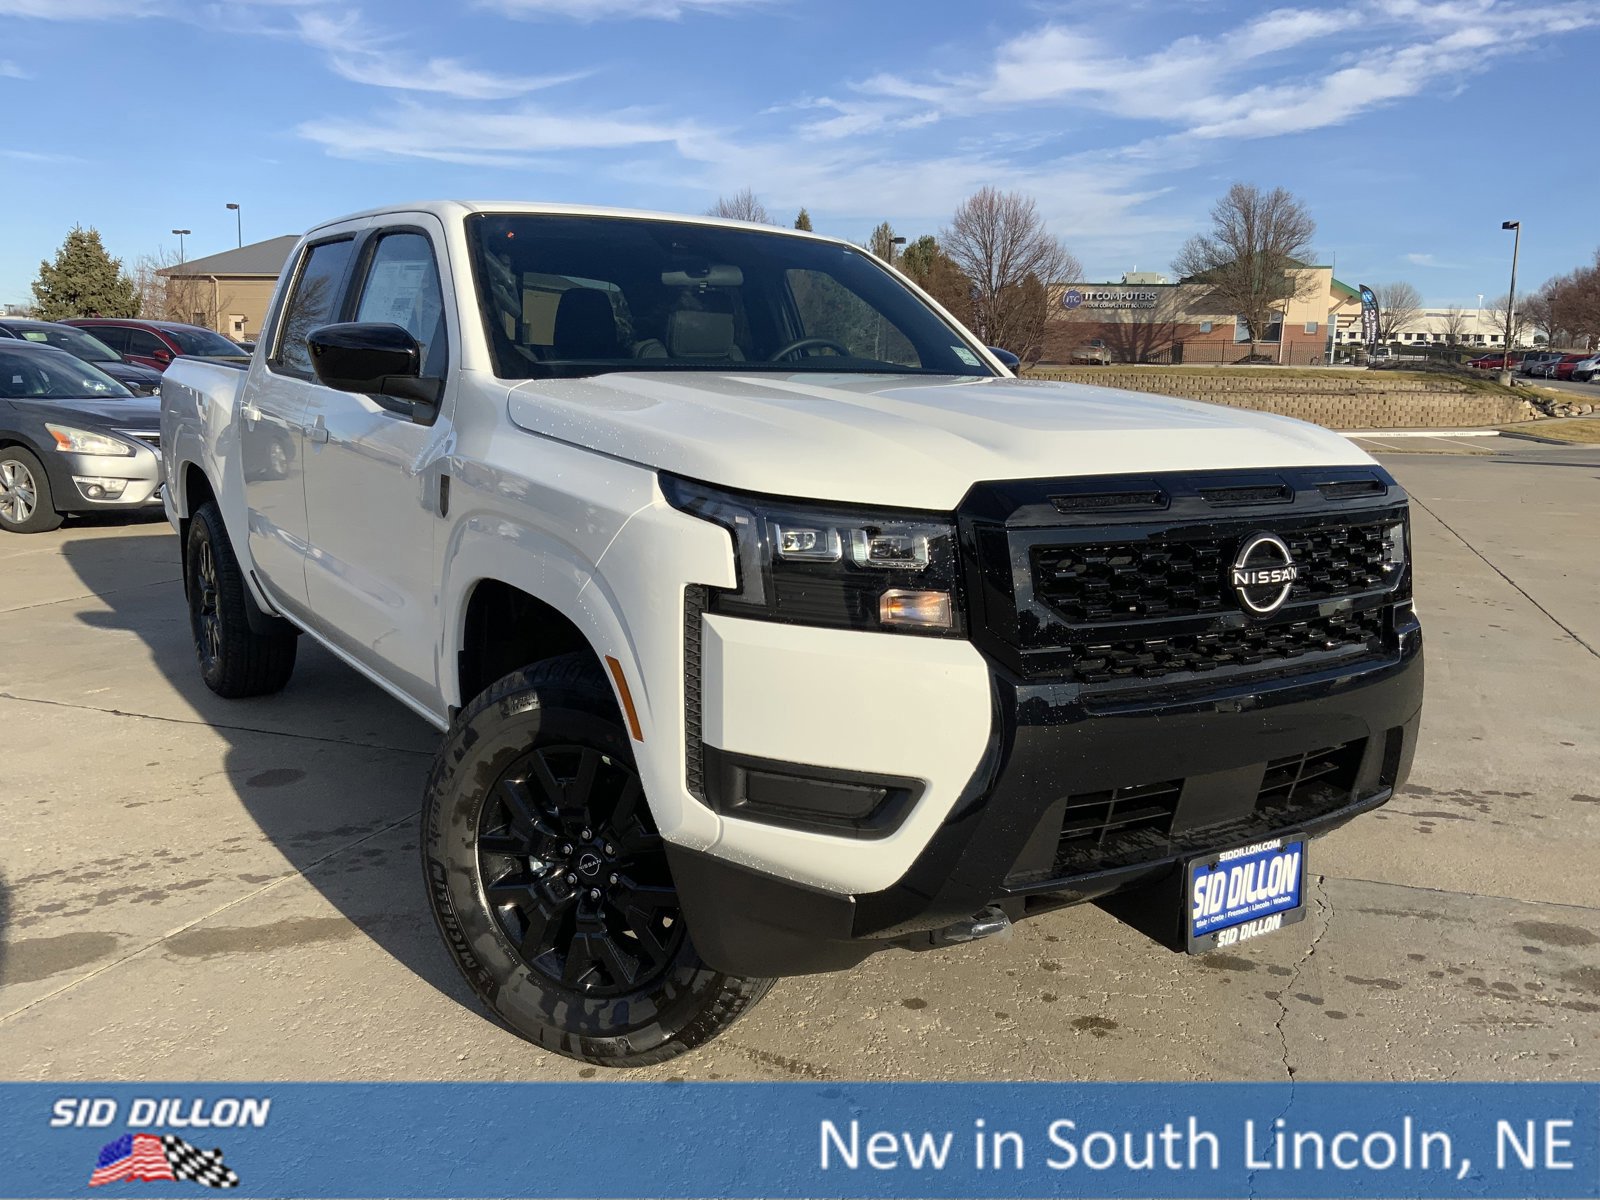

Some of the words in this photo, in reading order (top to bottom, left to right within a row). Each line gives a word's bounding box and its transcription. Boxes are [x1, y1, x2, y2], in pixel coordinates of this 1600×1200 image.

[1066, 295, 1080, 303] ITC
[1085, 292, 1095, 300] IT
[1096, 291, 1157, 301] COMPUTERS
[1233, 566, 1297, 585] NISSAN
[1219, 839, 1281, 861] SIDDILLON.COM
[578, 859, 602, 870] NISSAN
[1192, 871, 1227, 919] SID
[1226, 852, 1299, 909] DILLON
[432, 864, 478, 968] MICHELIN
[1211, 914, 1225, 923] Crete
[1227, 906, 1249, 917] Fremont
[1251, 901, 1270, 910] Lincoln
[1273, 896, 1291, 905] Wahoo
[1217, 927, 1239, 947] SID
[1239, 913, 1282, 940] DILLON
